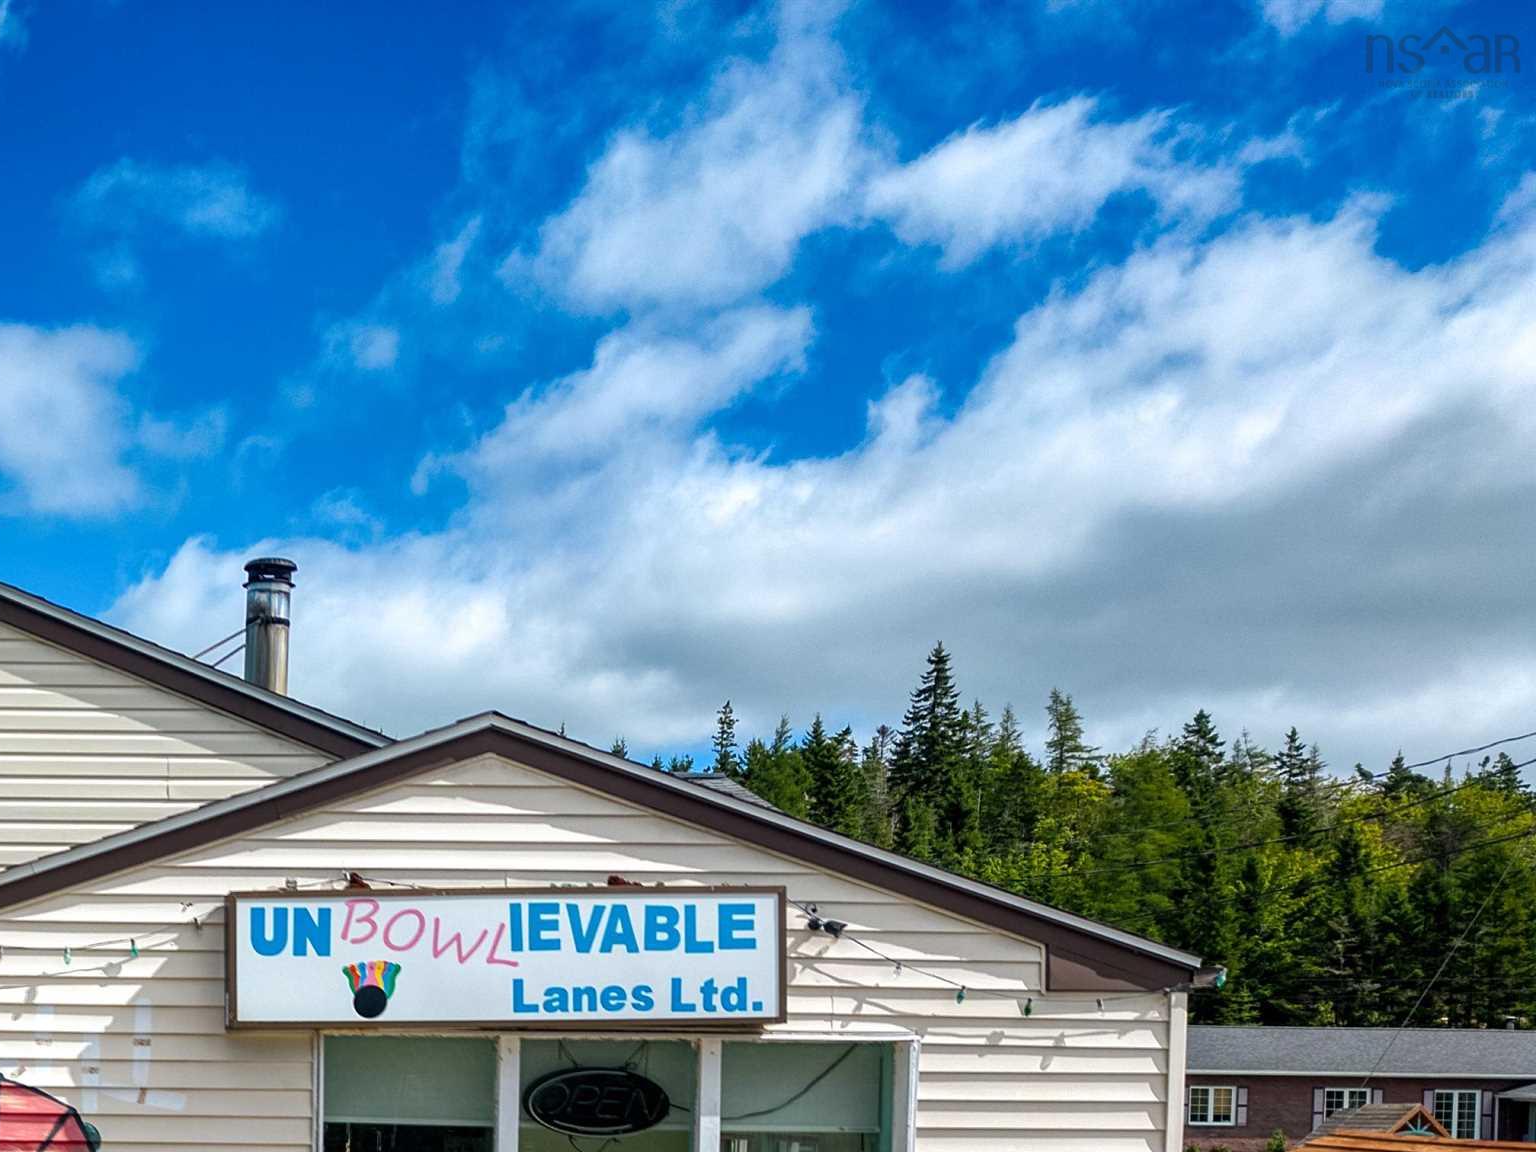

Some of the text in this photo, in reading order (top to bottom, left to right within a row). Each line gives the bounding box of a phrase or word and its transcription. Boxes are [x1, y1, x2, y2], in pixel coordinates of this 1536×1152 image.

[249, 898, 757, 968] UN BOWL IEVABLE
[512, 976, 764, 1014] Lanes Ltd.
[530, 1082, 667, 1124] OPEN
